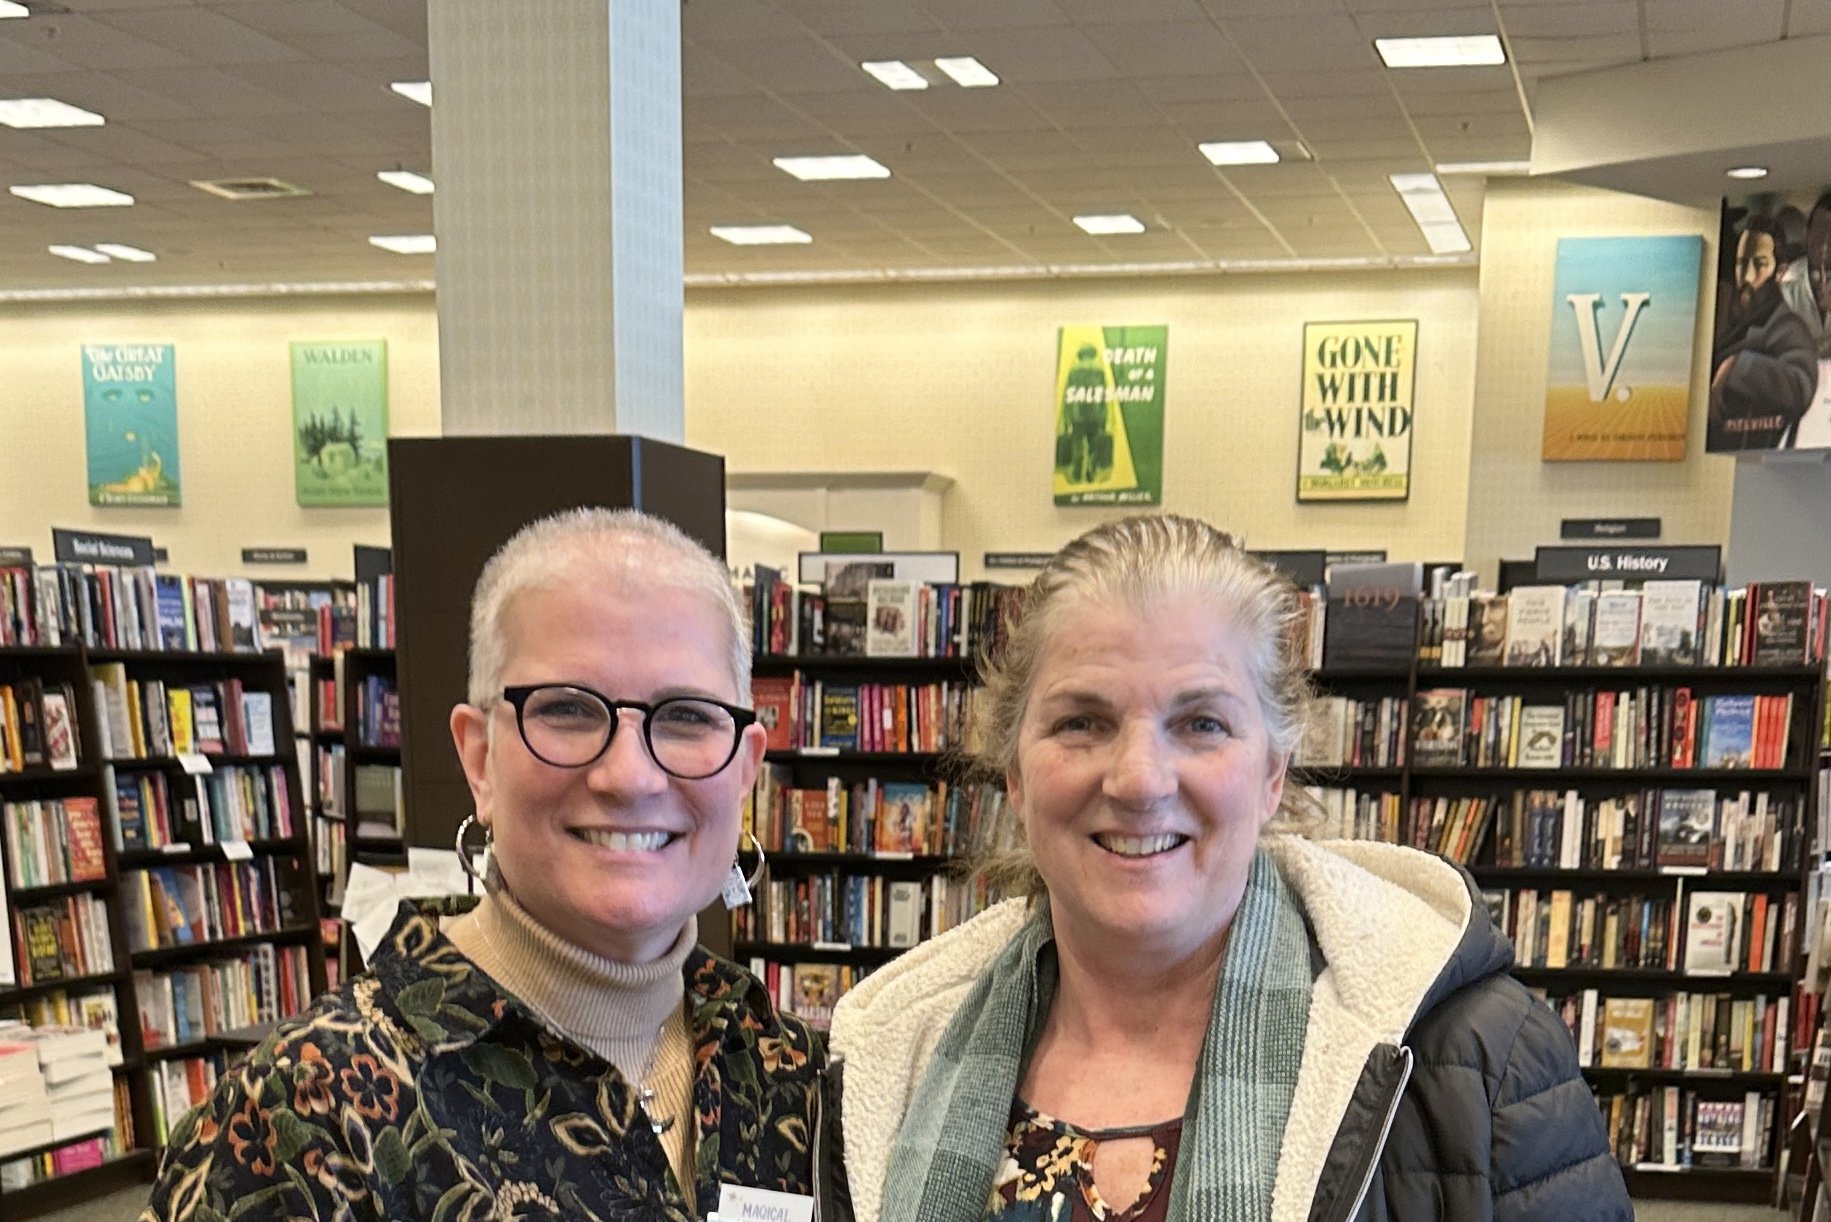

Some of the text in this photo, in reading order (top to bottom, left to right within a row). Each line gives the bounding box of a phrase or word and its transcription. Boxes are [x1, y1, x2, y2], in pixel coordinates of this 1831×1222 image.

[303, 348, 373, 365] WALDEN
[1103, 347, 1157, 365] DEATH
[1318, 335, 1402, 368] GONE
[1065, 385, 1154, 404] SALESMAN
[1316, 371, 1399, 404] WITH
[1325, 406, 1411, 438] WIND
[1586, 555, 1670, 573] U.S. History
[1343, 584, 1401, 613] 1619
